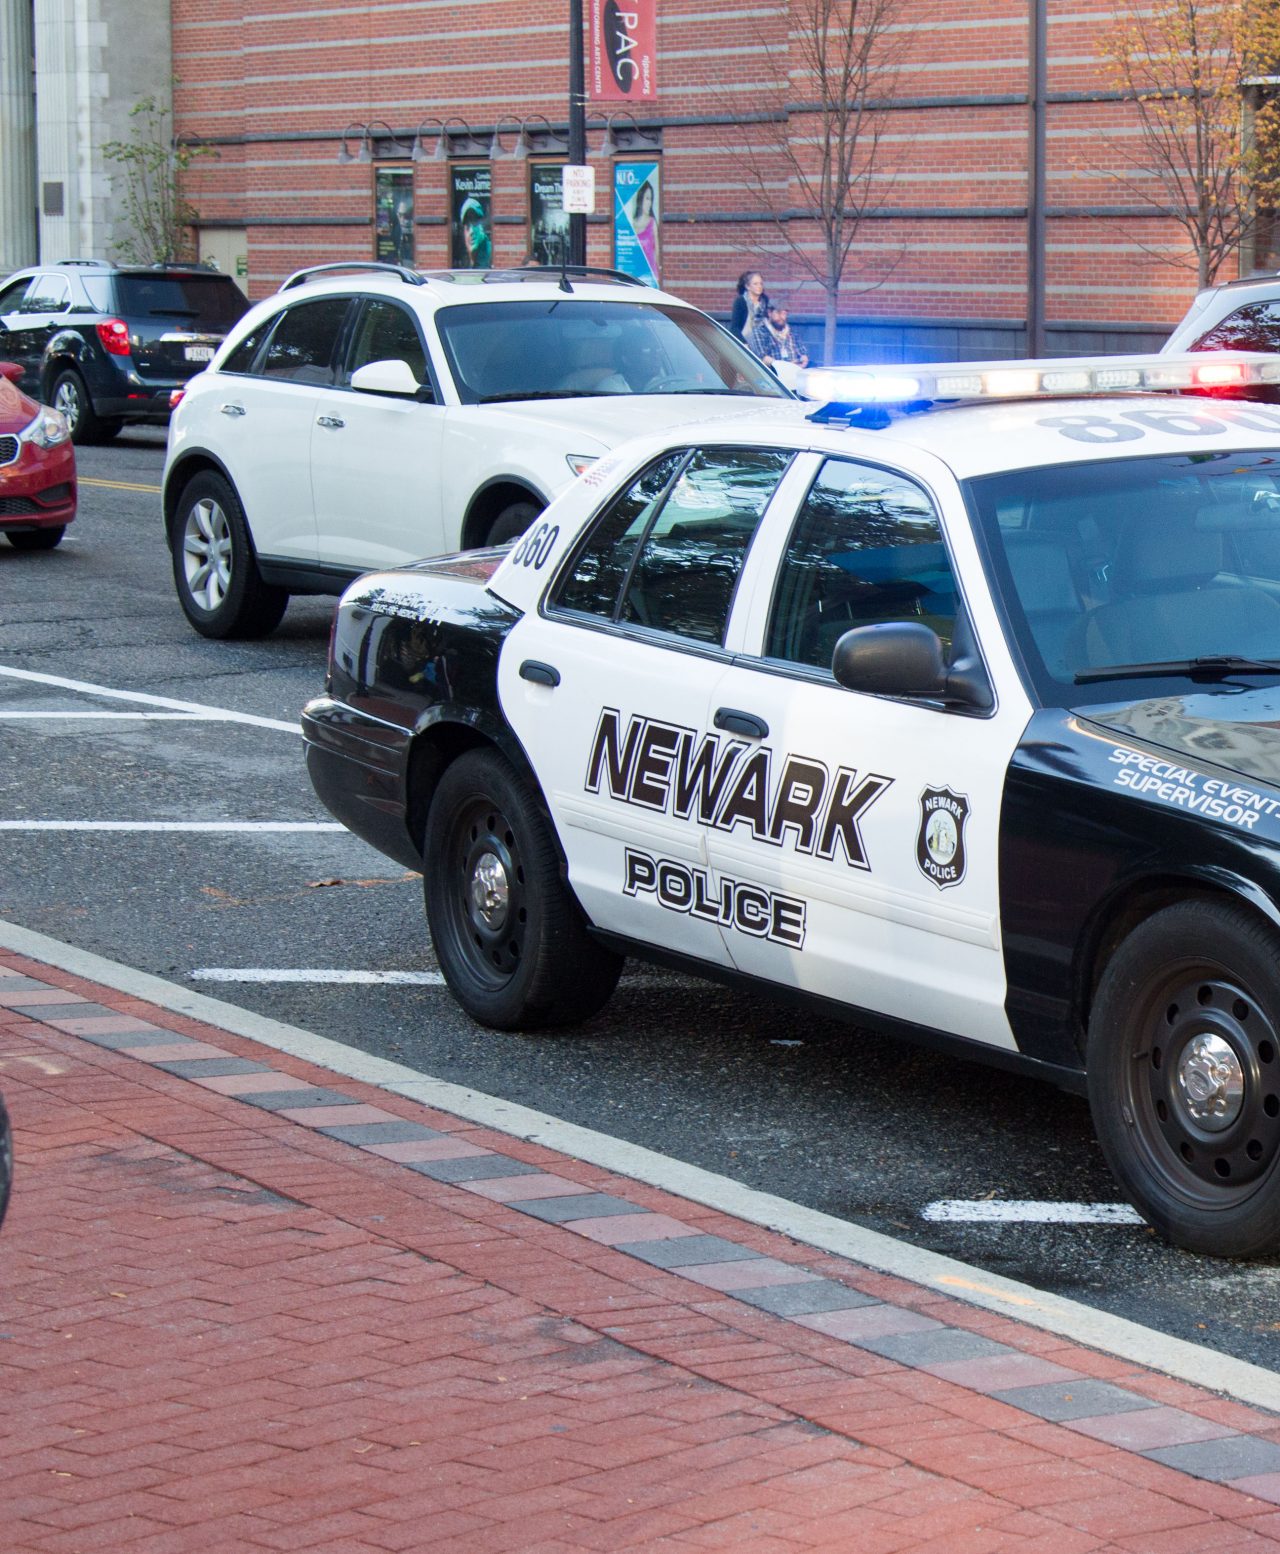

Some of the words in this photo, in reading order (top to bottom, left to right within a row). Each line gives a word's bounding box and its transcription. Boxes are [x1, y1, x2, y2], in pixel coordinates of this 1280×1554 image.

[615, 12, 640, 80] PAC
[642, 55, 650, 95] njpac.org
[455, 178, 474, 191] Kevin
[513, 522, 560, 571] 860
[584, 706, 896, 873] NEWARK
[1108, 748, 1201, 788] SPECIAL
[925, 796, 964, 820] NEWARK
[1113, 768, 1260, 830] SUPERVISOR
[923, 858, 957, 880] POLICE
[622, 846, 807, 952] POLICE
